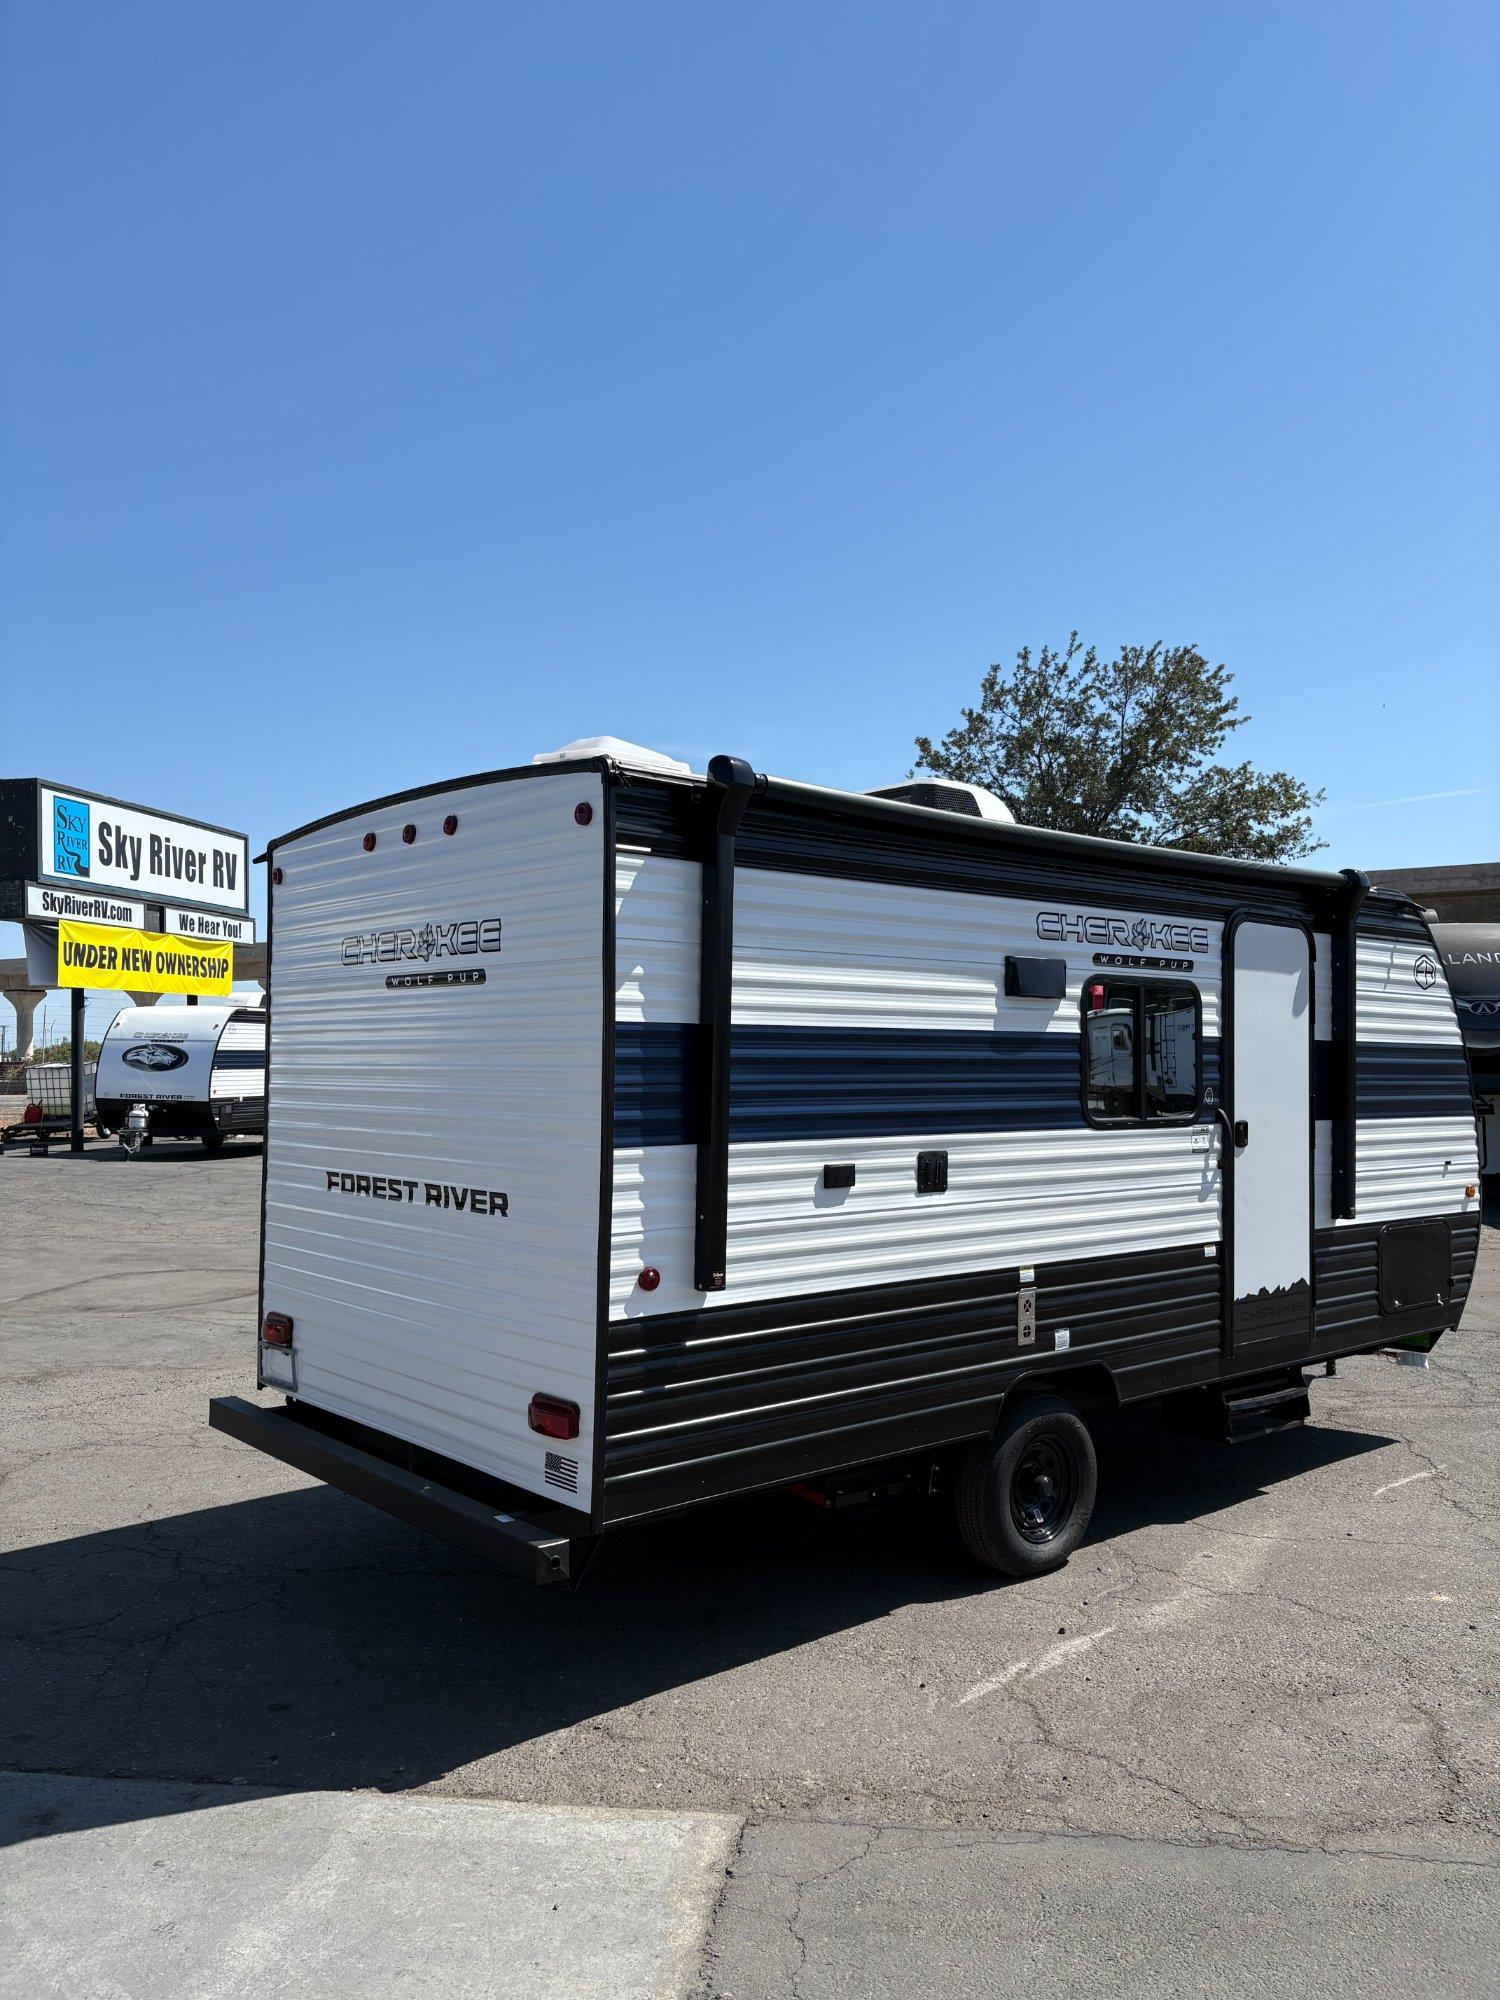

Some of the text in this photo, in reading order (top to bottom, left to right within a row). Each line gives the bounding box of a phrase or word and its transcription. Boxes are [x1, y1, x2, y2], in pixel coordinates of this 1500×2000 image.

[57, 855, 74, 870] RV
[98, 821, 238, 891] Sky River RV
[42, 891, 132, 922] SkyRiverRV.com
[179, 913, 242, 938] We Hear You!
[63, 941, 229, 979] UNDER NEW OWNERSHIP
[1100, 955, 1189, 970] WOLF PUP
[1441, 952, 1500, 966] LAN
[391, 972, 479, 987] WOLF PUP
[326, 1171, 509, 1217] FOREST RIVER
